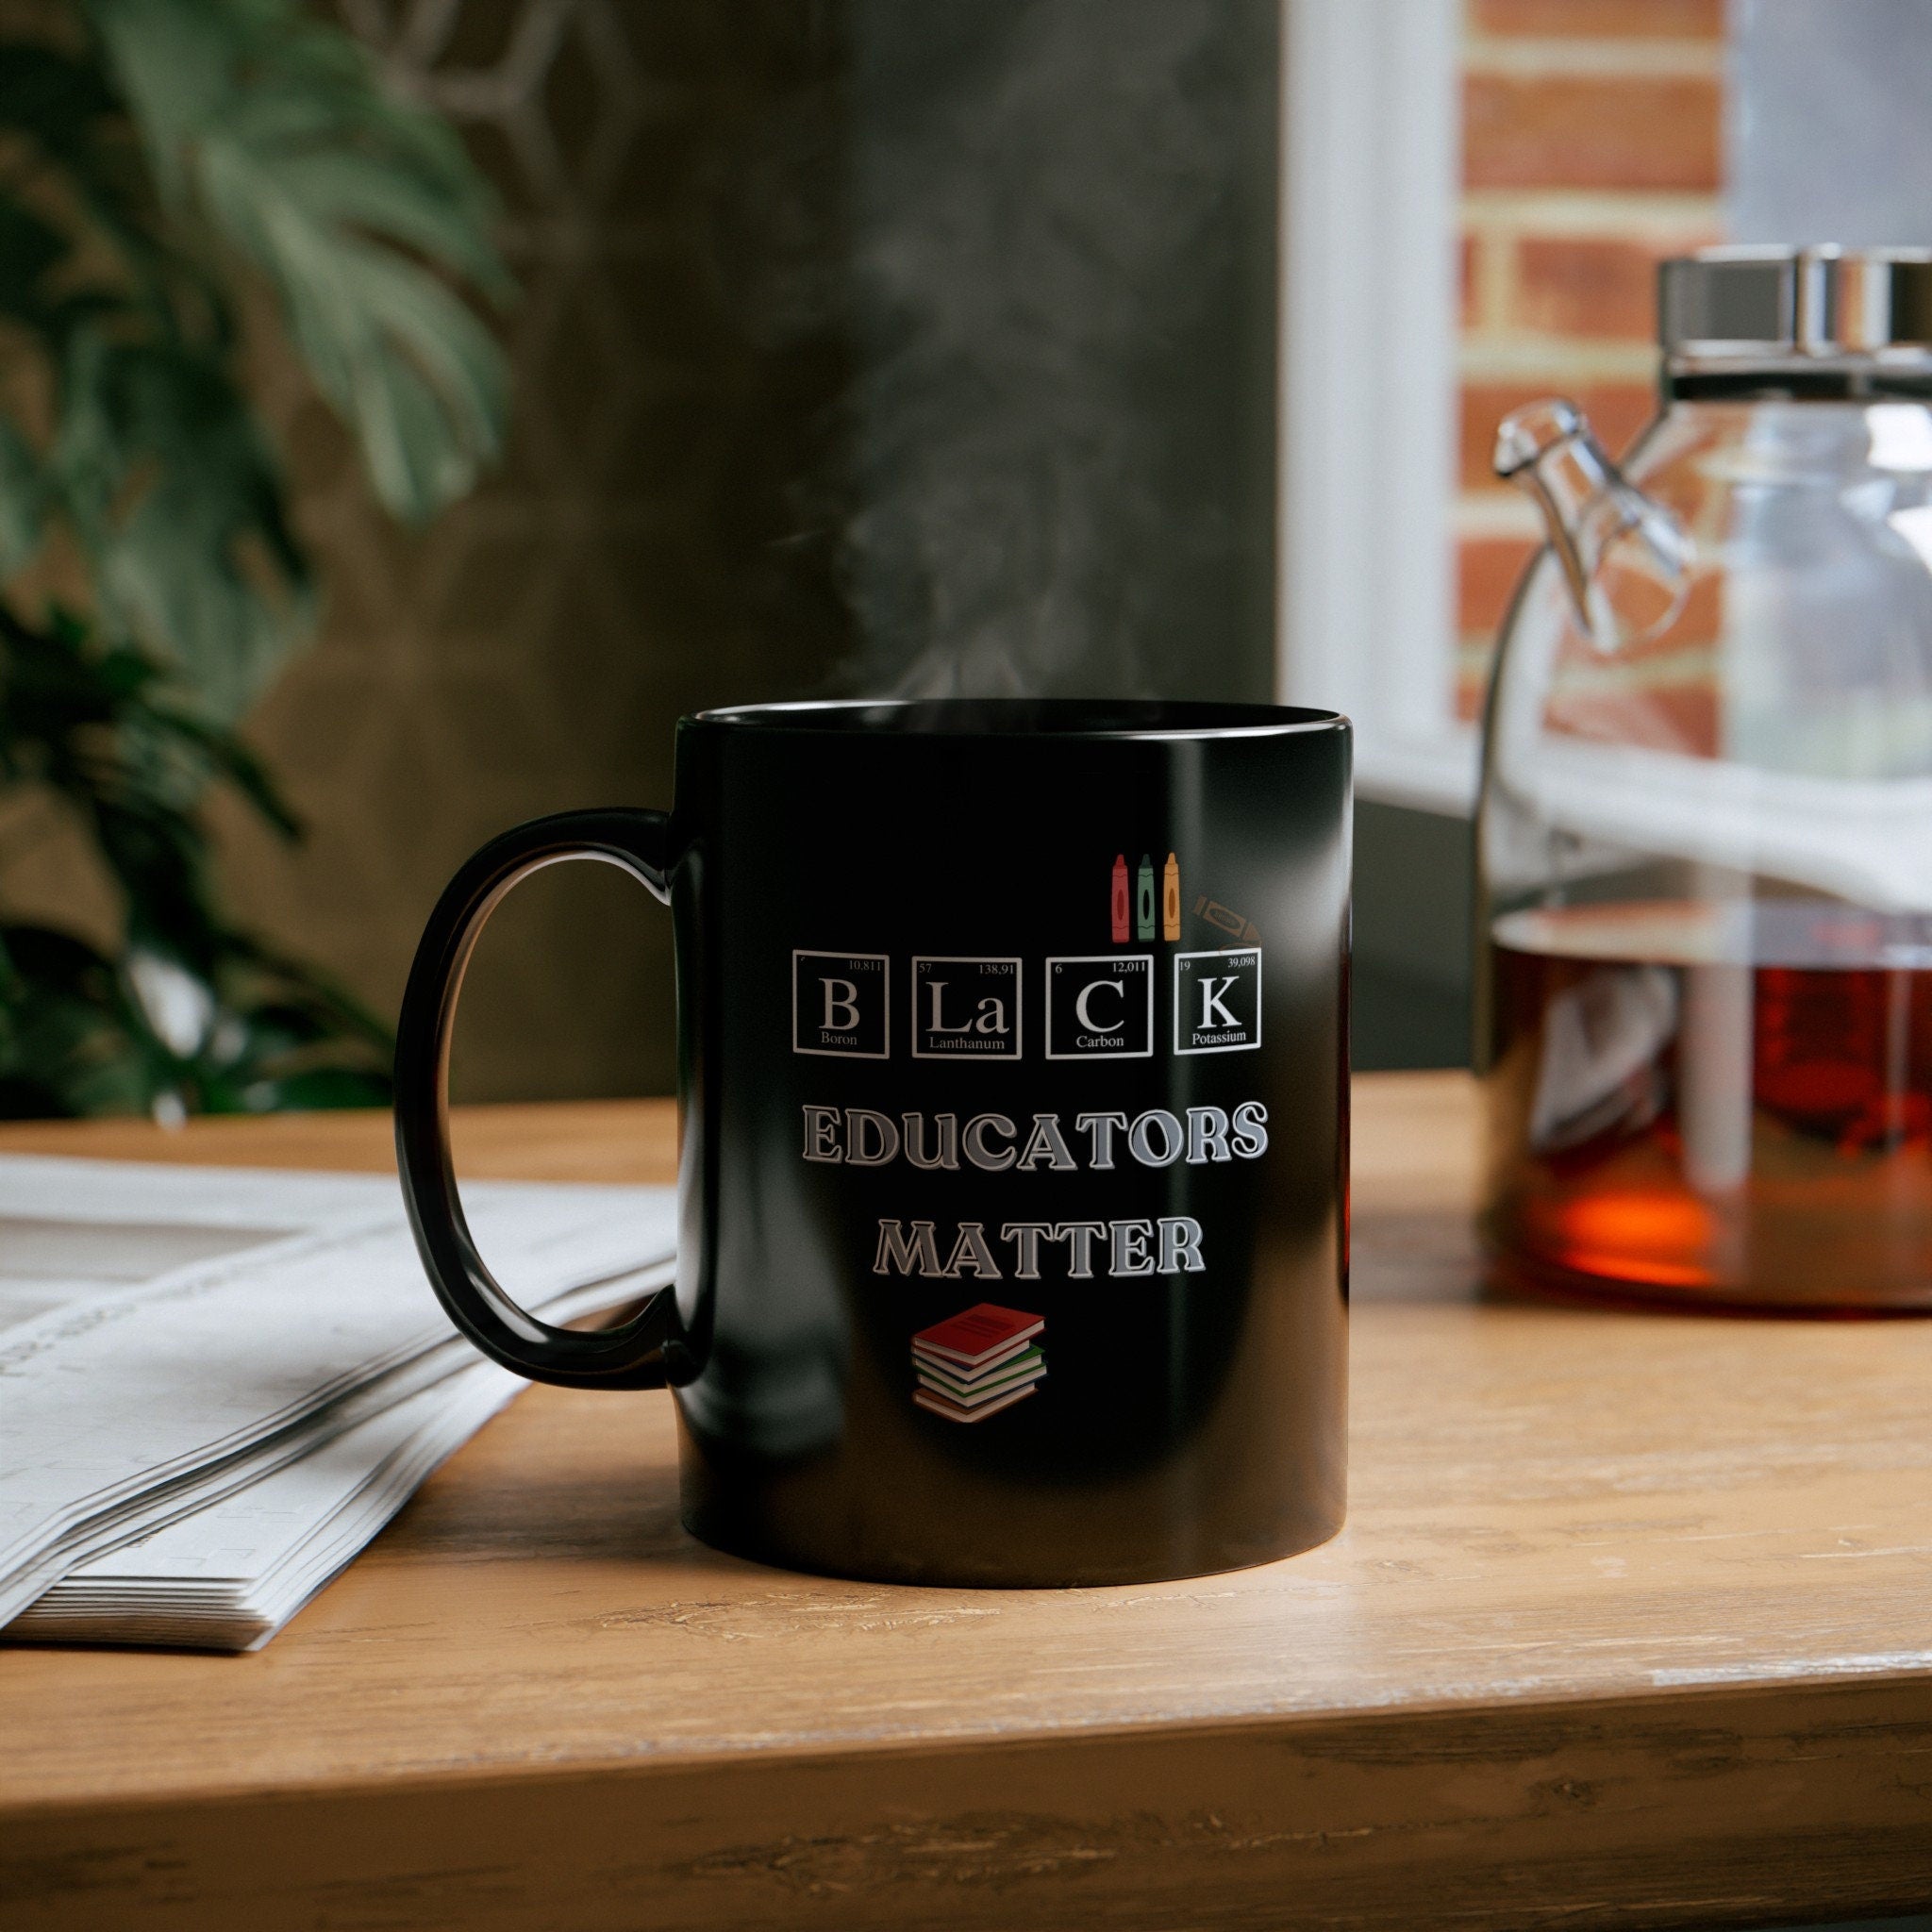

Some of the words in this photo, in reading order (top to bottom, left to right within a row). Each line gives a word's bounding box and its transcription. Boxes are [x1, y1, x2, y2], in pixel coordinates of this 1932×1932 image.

[919, 963, 932, 974] 57
[1055, 964, 1063, 974] 6
[1112, 961, 1145, 974] 12,011
[1179, 960, 1191, 972] 19
[818, 977, 860, 1030] B
[925, 981, 1010, 1035] La
[1075, 979, 1124, 1033] C
[1197, 975, 1242, 1029] K
[821, 1031, 858, 1045] Boron
[929, 1037, 1005, 1050] Lanthanum
[1075, 1036, 1124, 1048] Carbon
[1191, 1029, 1247, 1045] Potassium
[802, 1101, 1269, 1171] EDUCATORS
[873, 1216, 1207, 1279] MATTER
